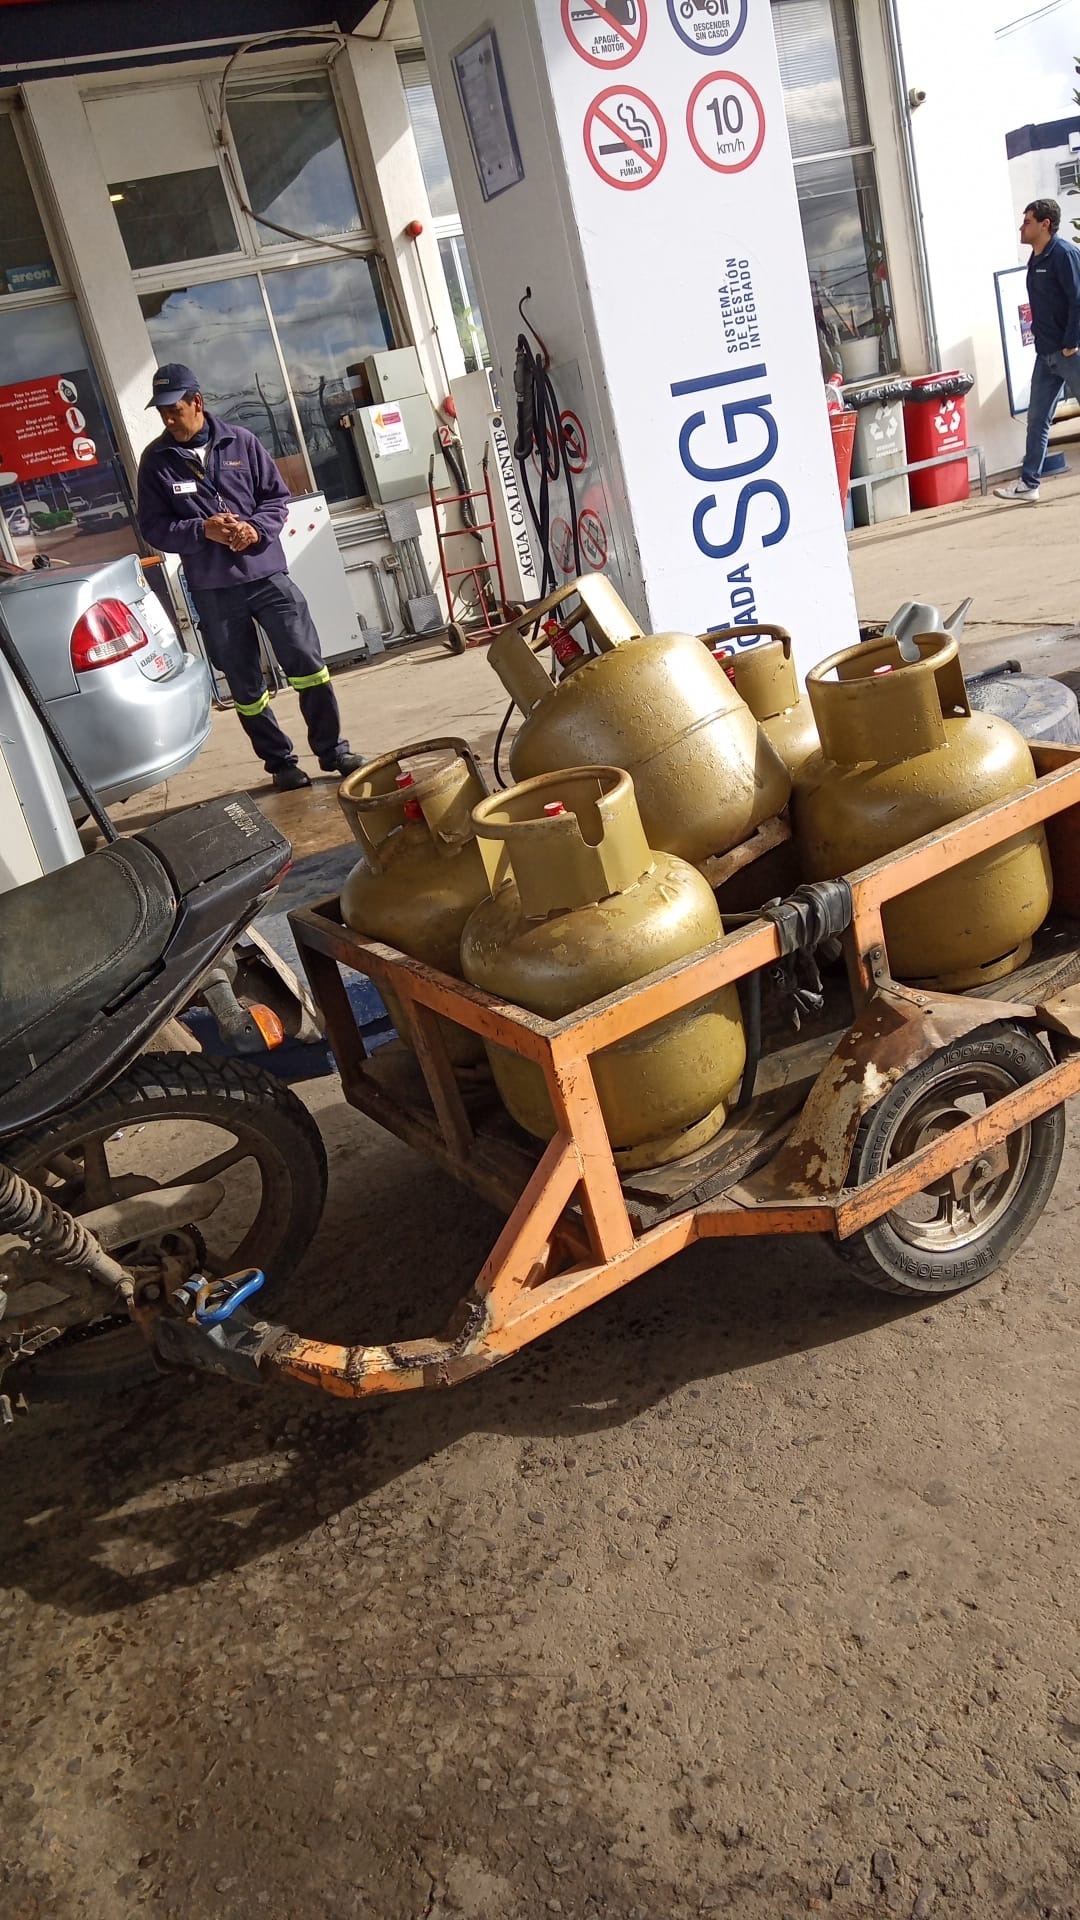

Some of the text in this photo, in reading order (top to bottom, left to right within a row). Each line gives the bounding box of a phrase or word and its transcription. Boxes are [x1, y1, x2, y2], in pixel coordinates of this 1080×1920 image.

[693, 20, 730, 32] DESCENDER
[696, 29, 729, 40] SIN CASCO
[592, 42, 625, 54] EL MOTOR
[594, 34, 620, 45] APAGUE
[706, 94, 744, 136] 10
[716, 138, 746, 155] km/h
[620, 165, 643, 177] FUMAR
[625, 158, 635, 167] NO
[725, 257, 750, 351] DE GESTIÓN
[738, 259, 761, 349] INTEGRADO
[718, 285, 738, 354] SISTEMA
[439, 427, 452, 445] 2
[670, 362, 791, 559] SGI
[494, 429, 535, 578] AGUA CALIENTE
[868, 1086, 912, 1176] RINALDI
[894, 1246, 995, 1280] HIGH-BORN
